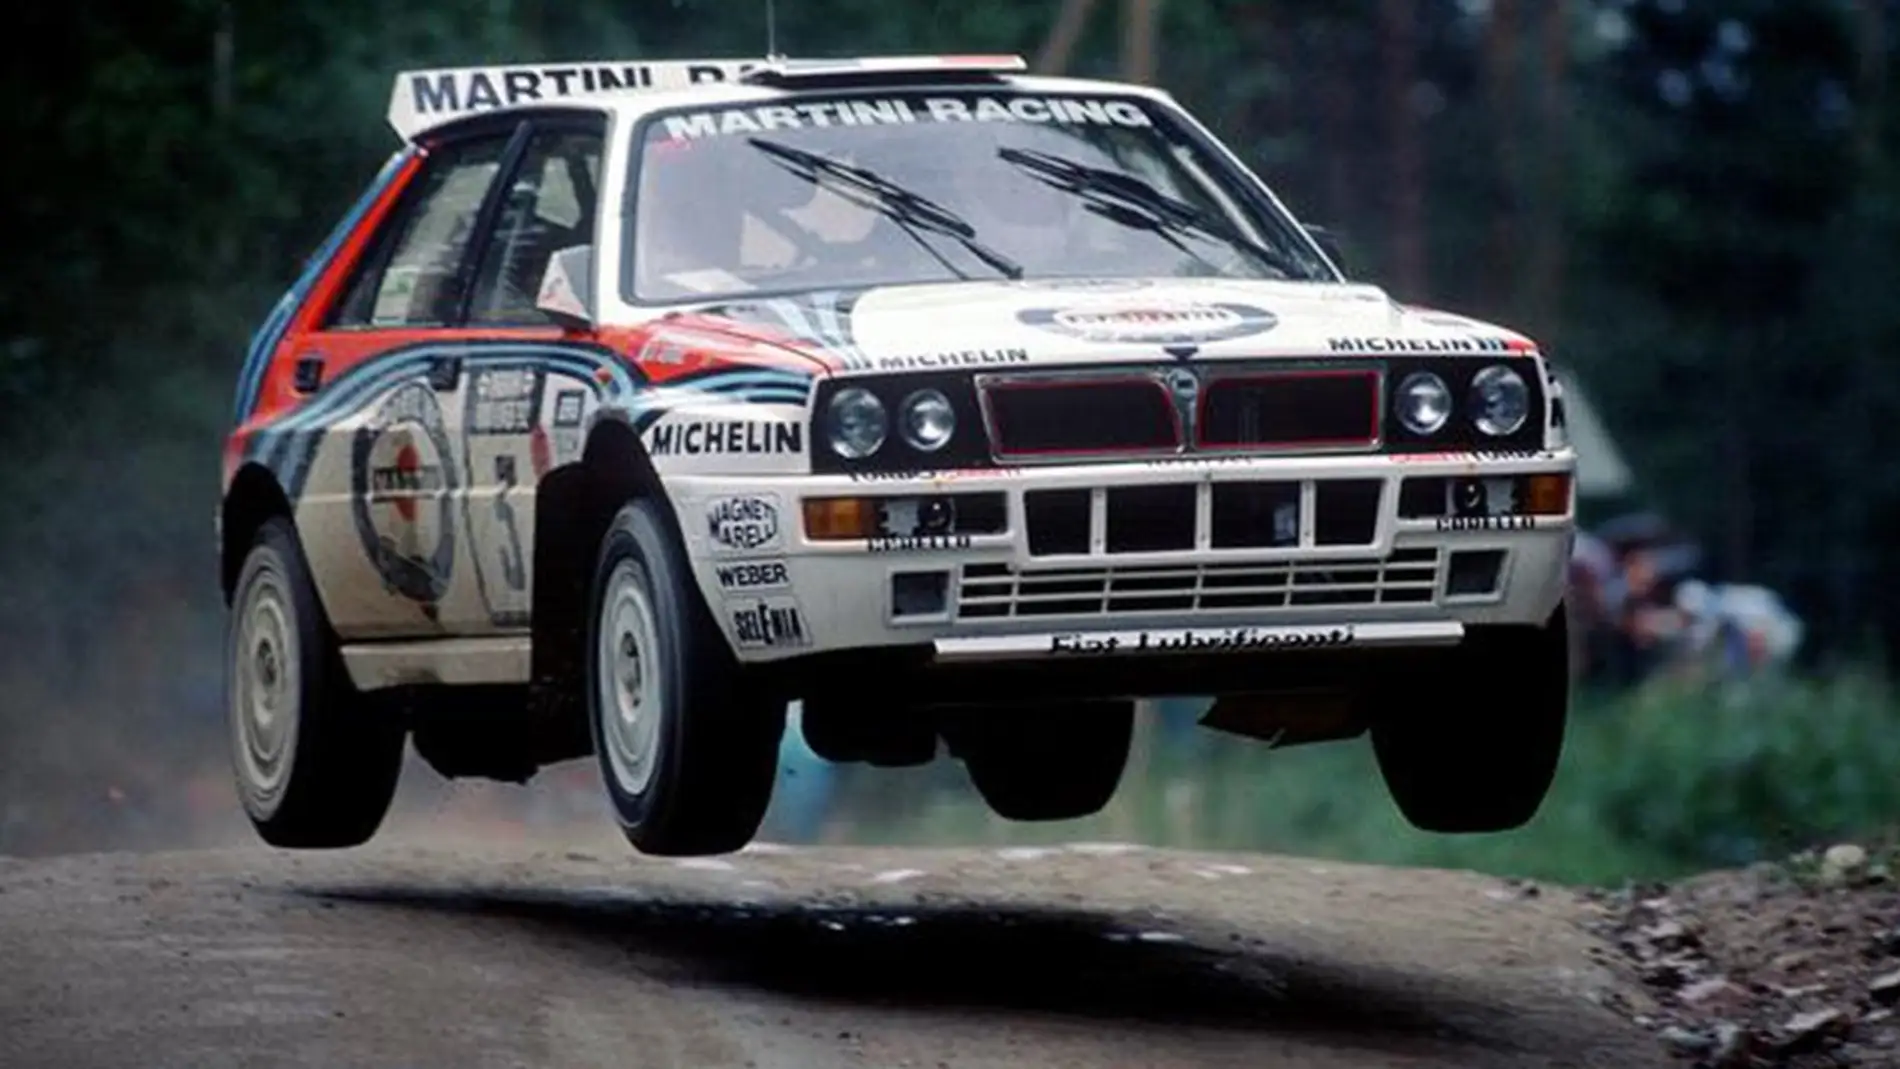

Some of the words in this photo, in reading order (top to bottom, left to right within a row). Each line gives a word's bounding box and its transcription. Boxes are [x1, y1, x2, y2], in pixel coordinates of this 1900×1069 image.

[411, 65, 653, 114] MARTINI
[664, 98, 918, 140] MARTINI
[925, 97, 1151, 127] RACING
[1327, 336, 1473, 352] MICHELIN
[879, 348, 1030, 369] MICHELIN
[650, 420, 803, 456] MICHELIN
[716, 563, 789, 588] WEBER
[1050, 635, 1121, 653] Fiat
